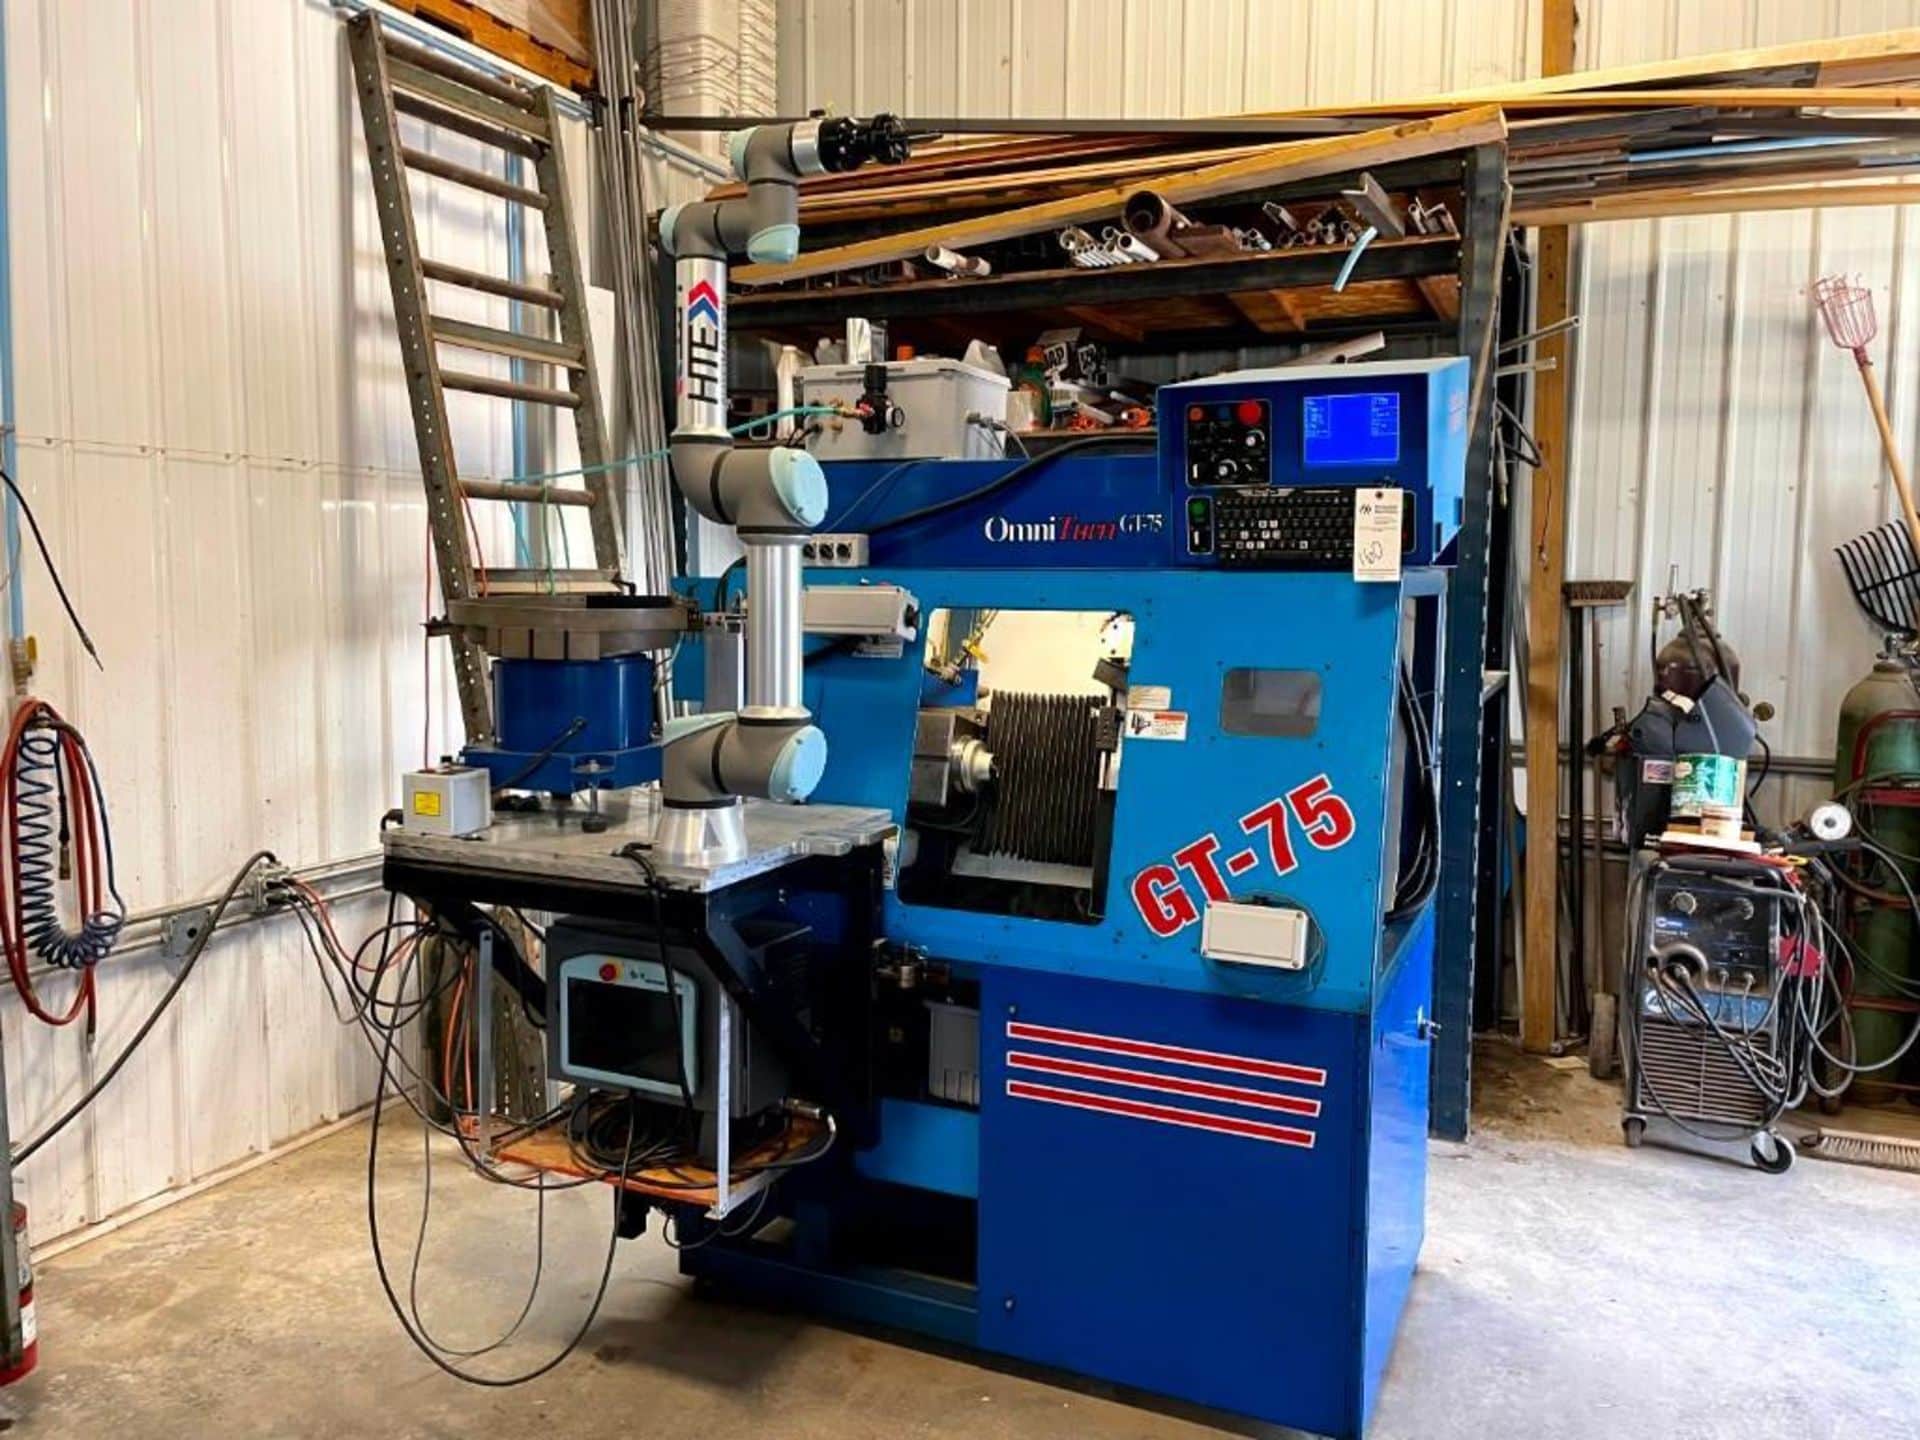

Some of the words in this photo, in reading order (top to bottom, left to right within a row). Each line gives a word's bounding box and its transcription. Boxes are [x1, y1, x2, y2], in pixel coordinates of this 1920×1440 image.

[984, 514, 1116, 542] OmniTurn
[1119, 513, 1163, 533] GT-75
[1131, 773, 1356, 937] GT-75
